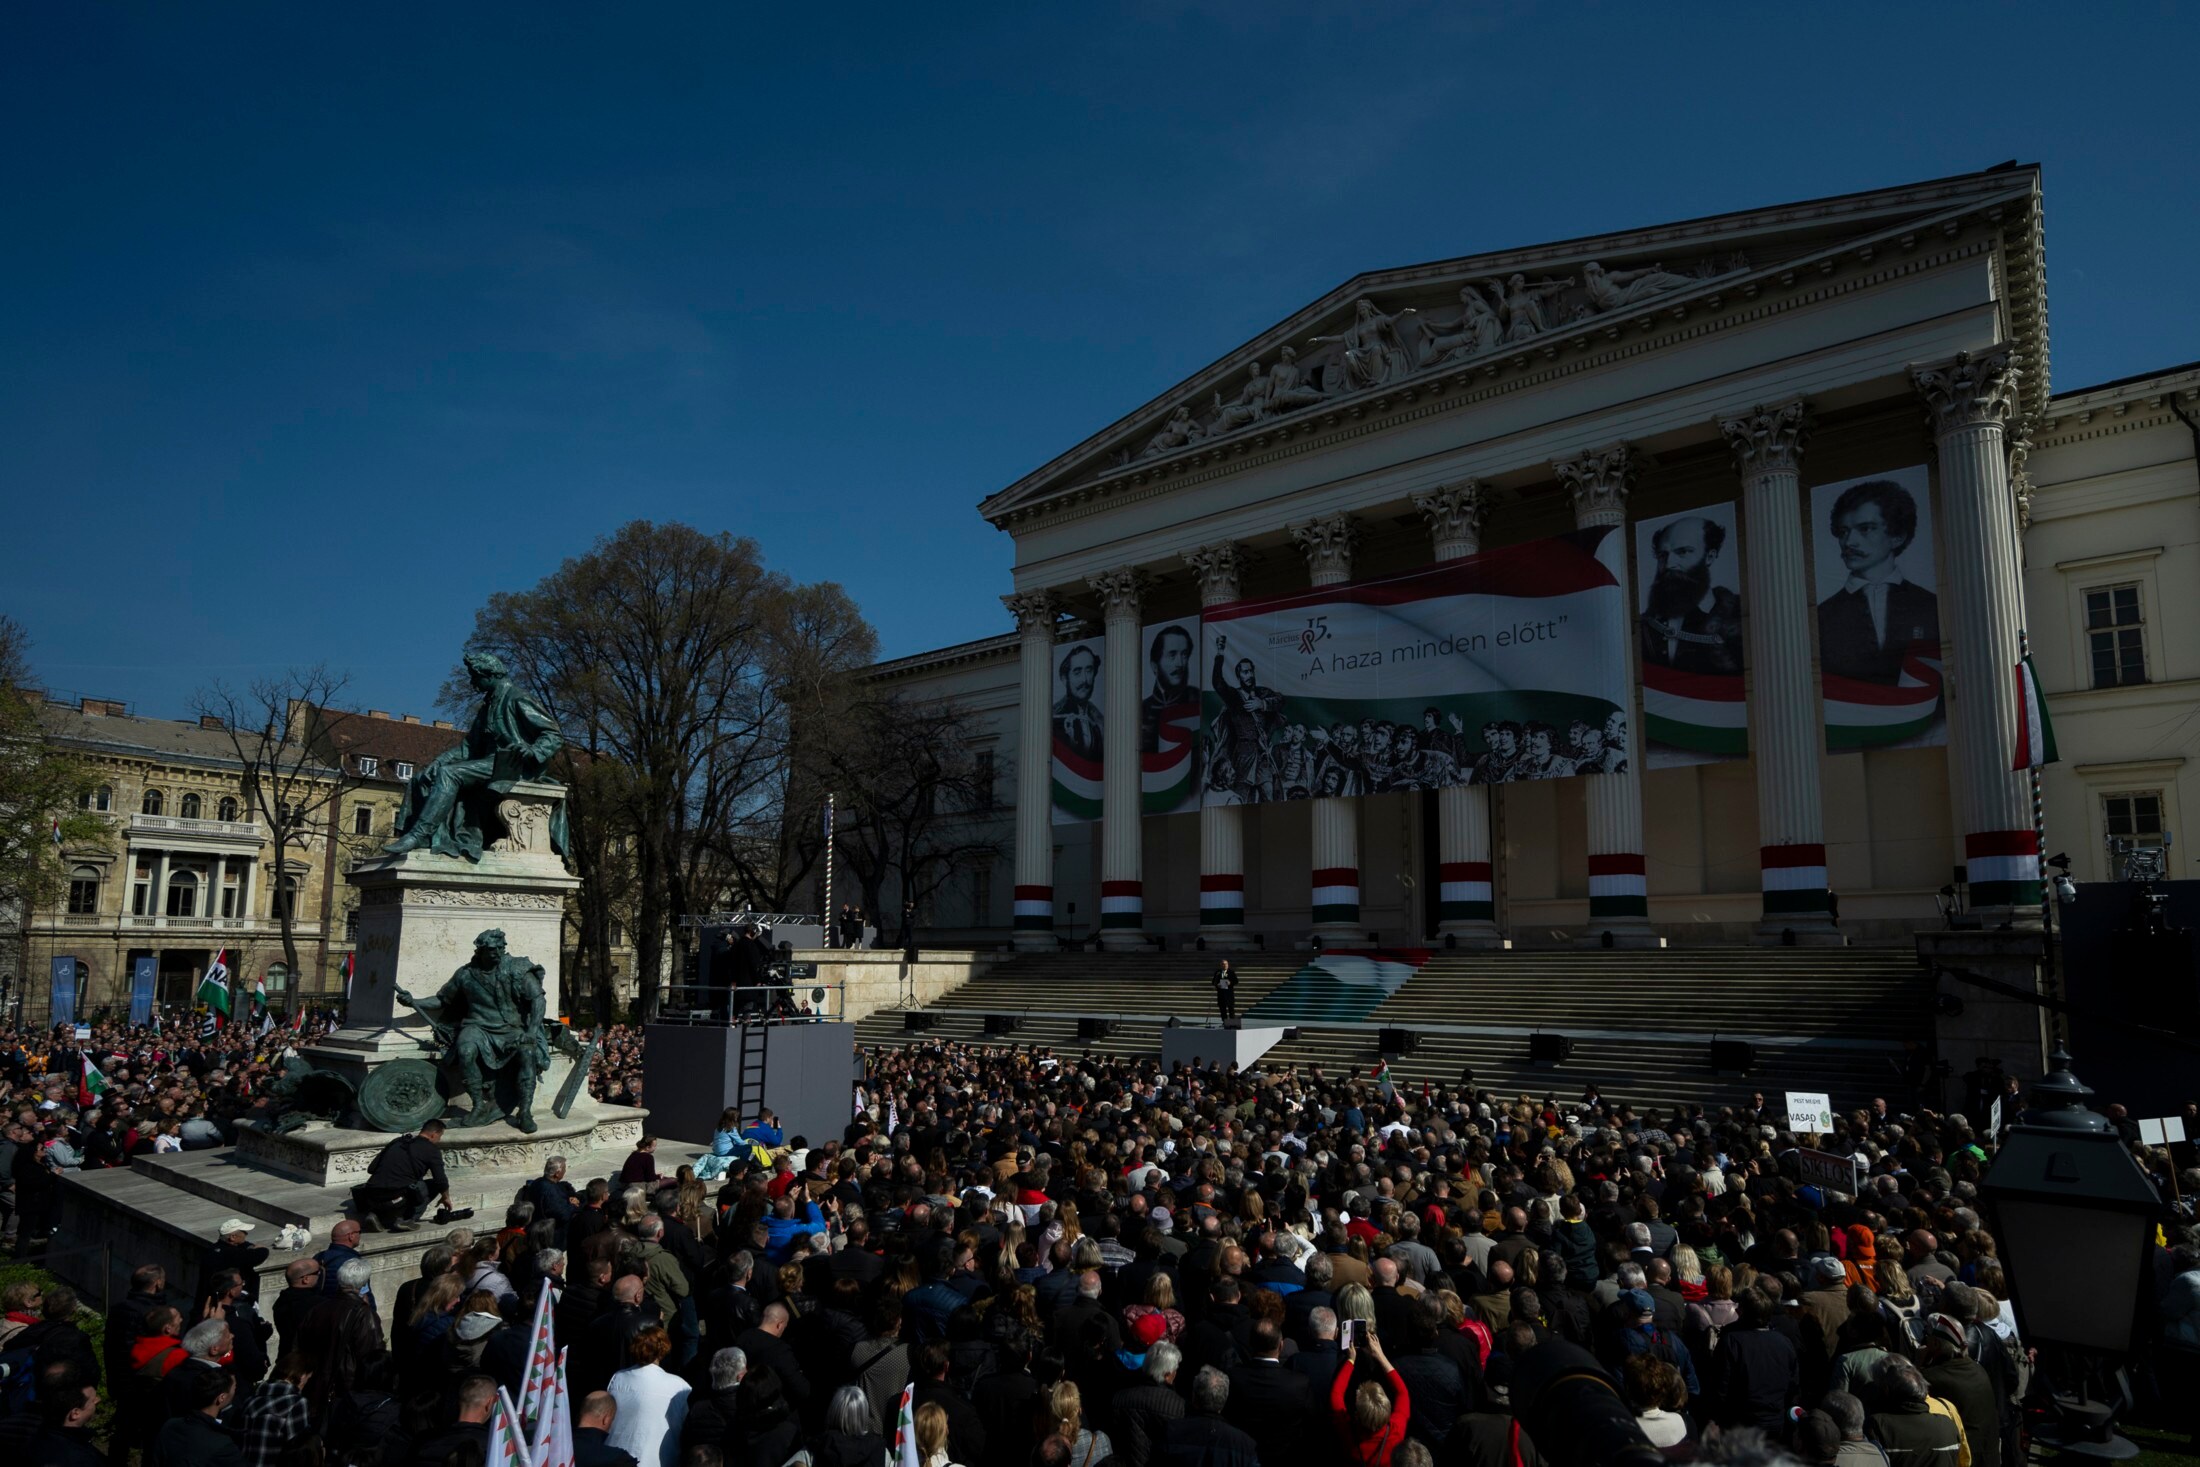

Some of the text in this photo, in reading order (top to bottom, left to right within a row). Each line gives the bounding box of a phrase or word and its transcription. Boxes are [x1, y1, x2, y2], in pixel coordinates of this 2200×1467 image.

[1268, 616, 1332, 646] Március 15.
[1332, 652, 1382, 672] haza
[1392, 633, 1486, 663] minden
[1789, 1113, 1816, 1122] VASAD
